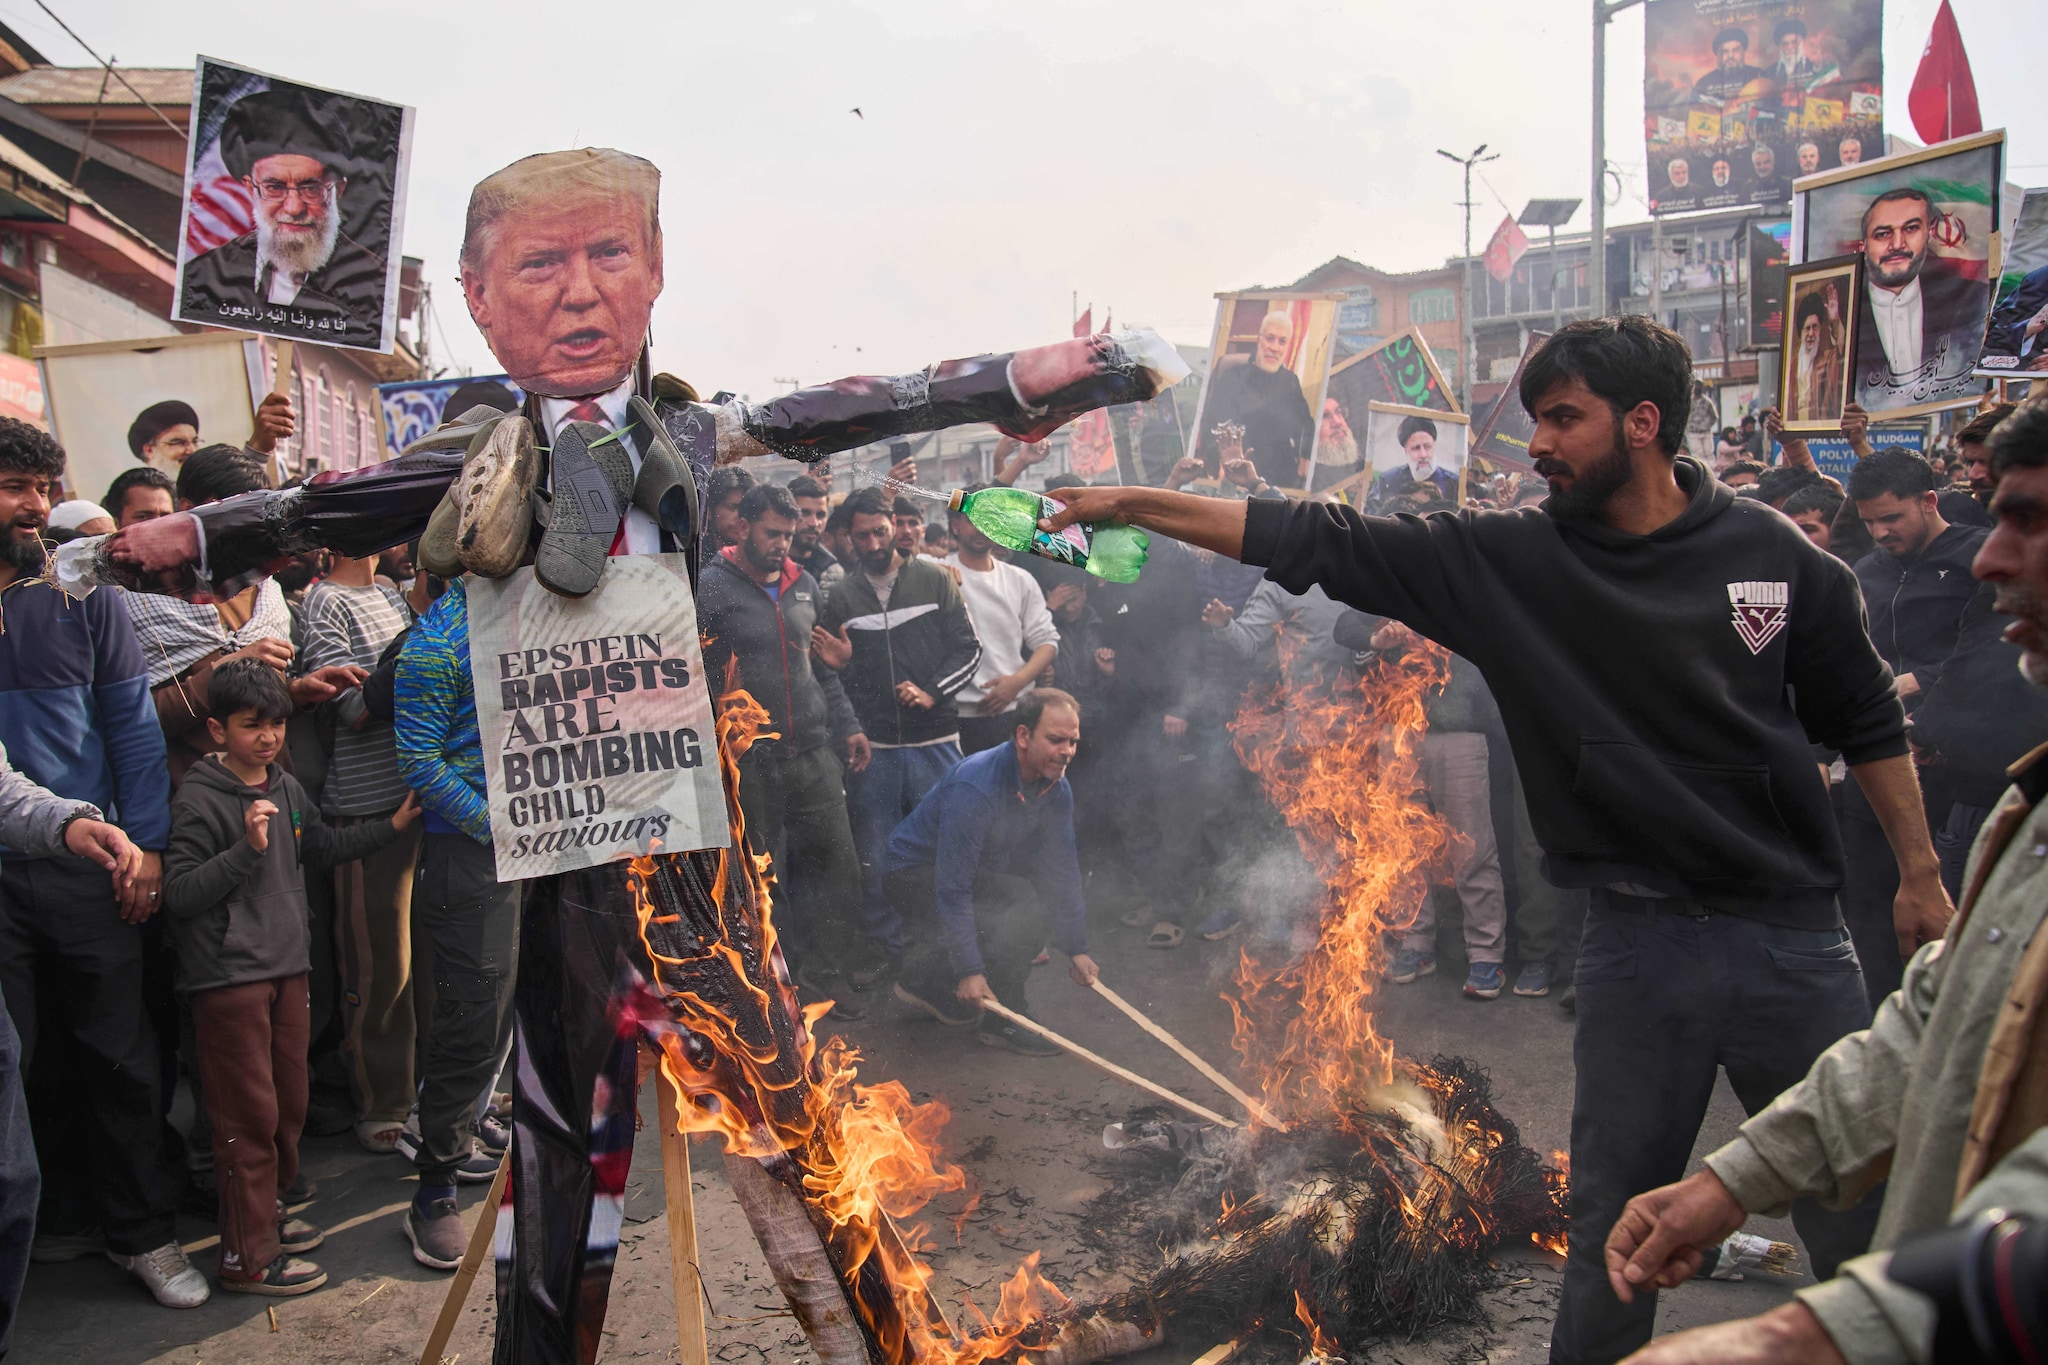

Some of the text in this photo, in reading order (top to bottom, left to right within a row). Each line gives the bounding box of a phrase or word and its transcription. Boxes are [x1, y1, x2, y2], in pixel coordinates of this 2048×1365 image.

[1819, 450, 1859, 460] POLYT
[1877, 434, 1920, 444] BUDGAM
[1726, 581, 1789, 604] PUMA
[497, 632, 663, 680] EPSTEIN
[500, 658, 690, 712] RAPISTS
[503, 693, 621, 750] ARE
[502, 727, 703, 794] BOMBING
[508, 783, 606, 828] CHILD
[511, 814, 671, 859] saviours
